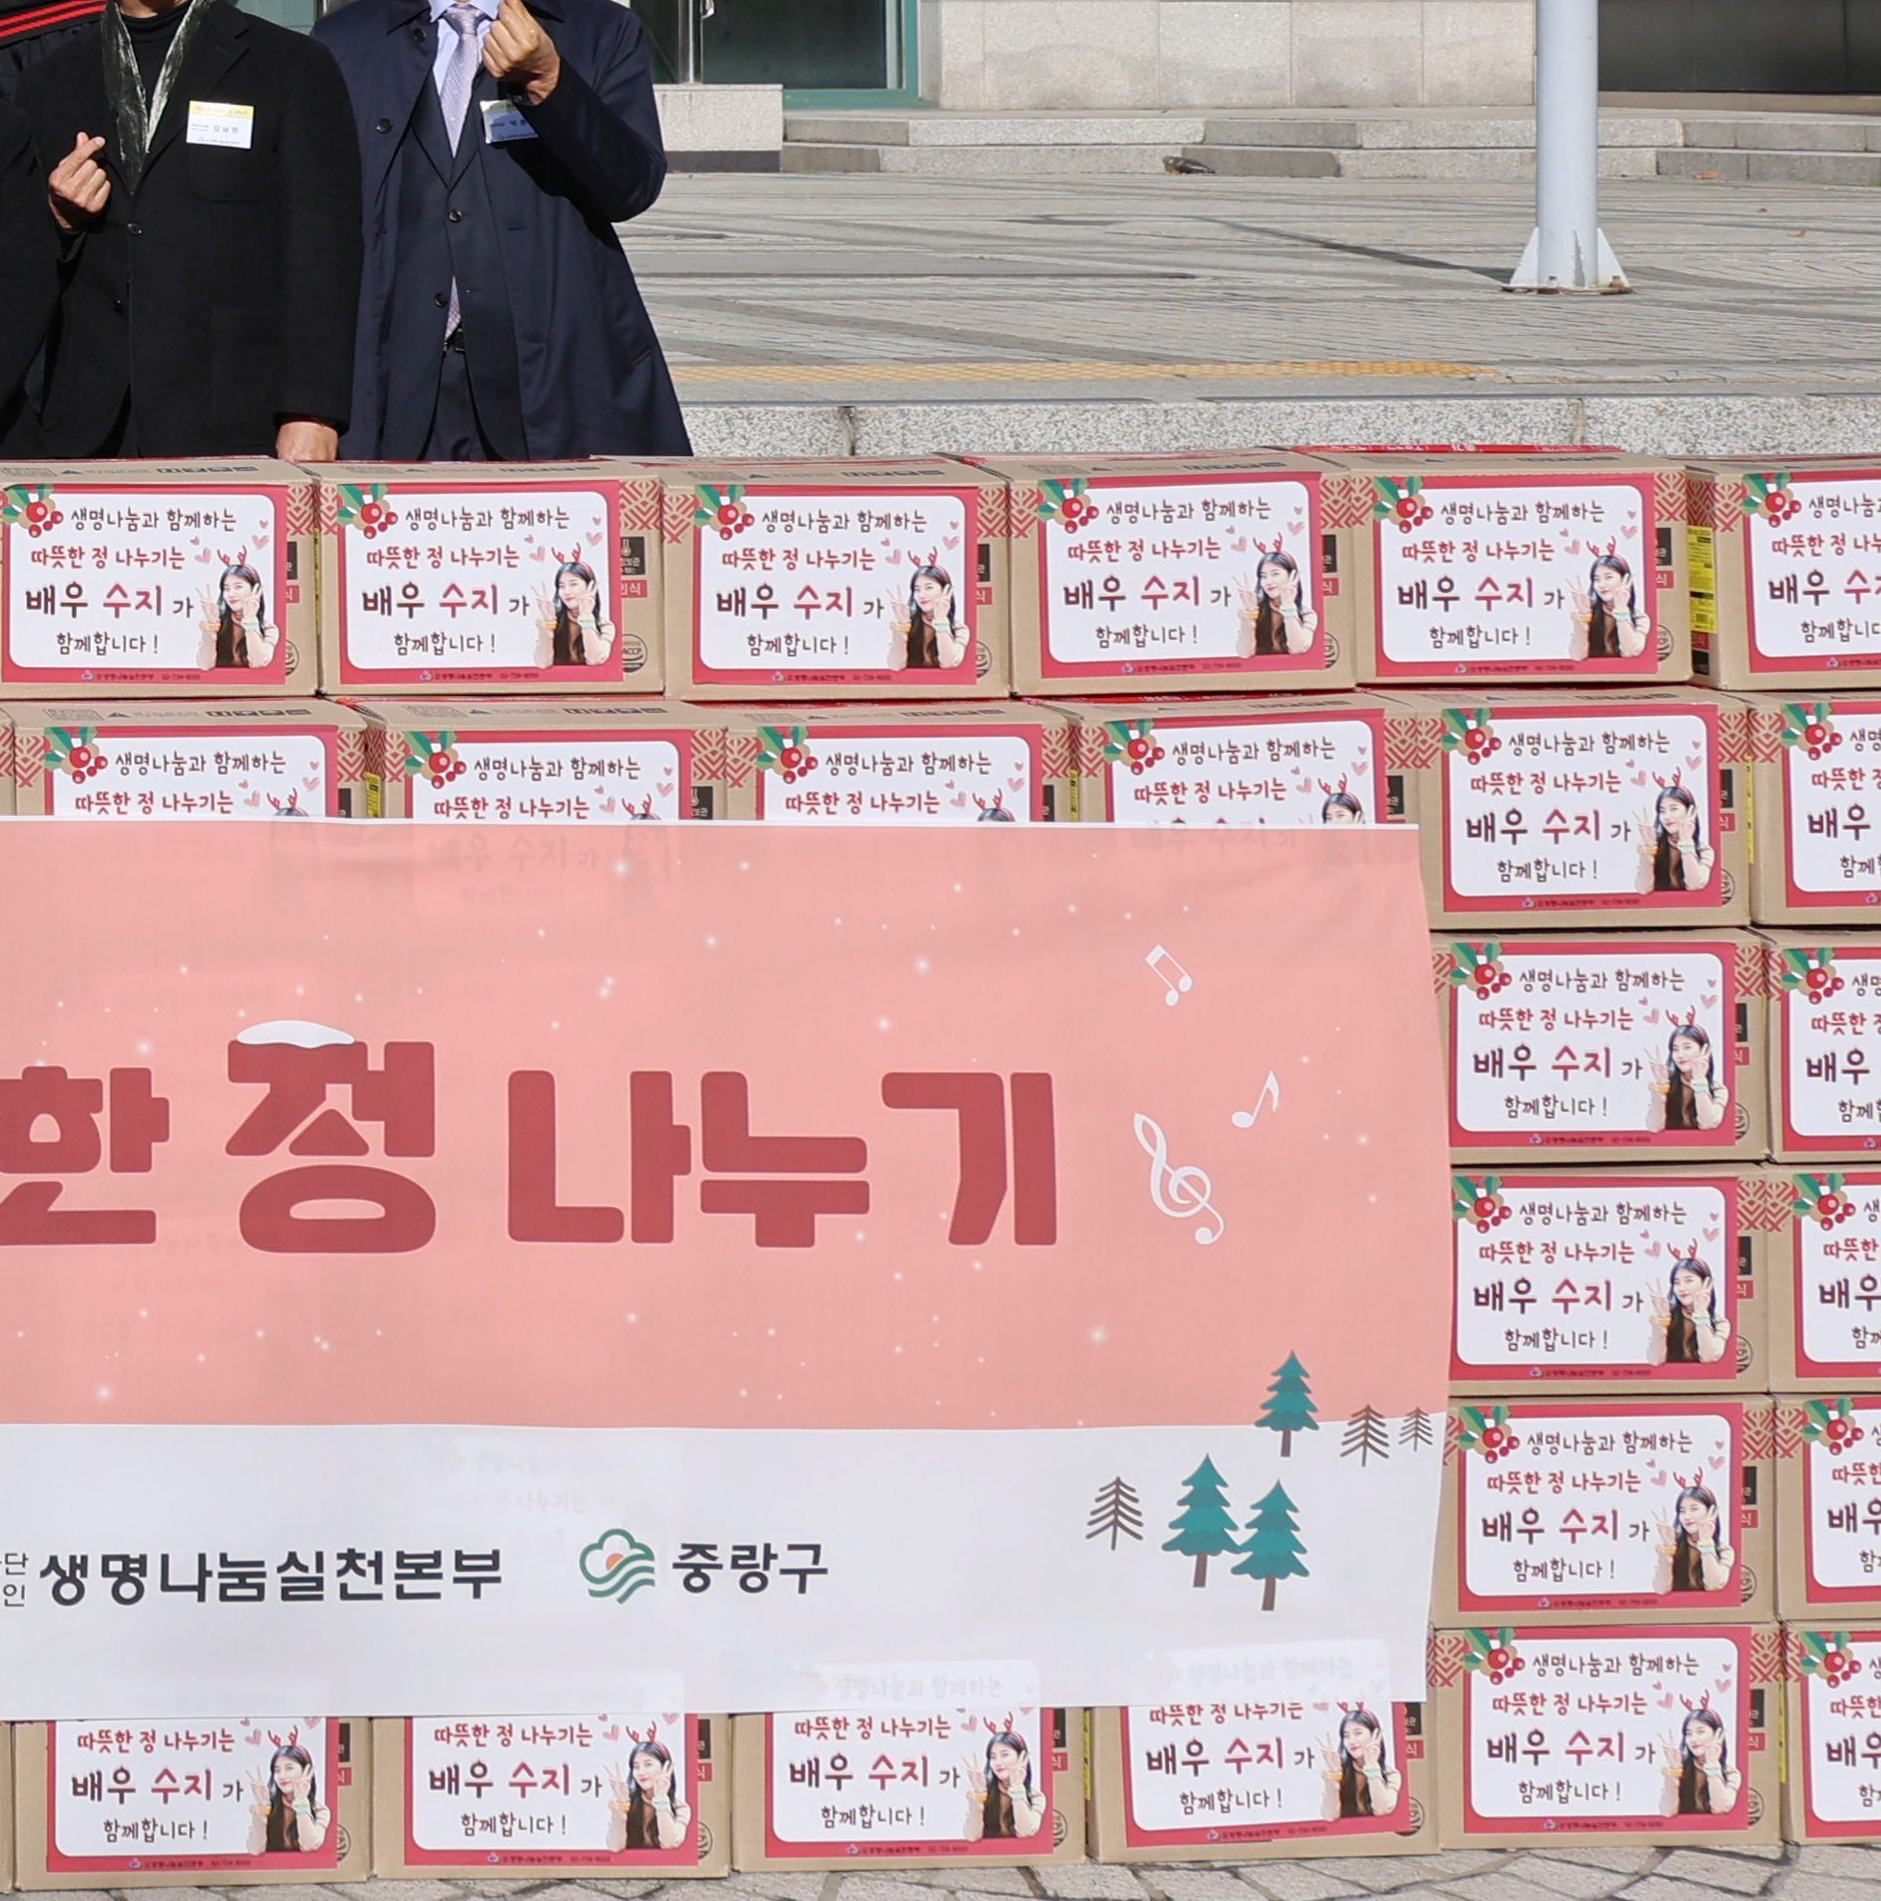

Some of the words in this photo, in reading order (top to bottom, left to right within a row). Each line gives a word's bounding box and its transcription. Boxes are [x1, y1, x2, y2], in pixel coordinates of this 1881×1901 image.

[762, 510, 850, 534] 생명나눔과
[857, 510, 927, 533] 함께하는
[722, 548, 776, 570] 따뜻한
[781, 547, 798, 572] 정
[807, 548, 875, 571] 나누기는
[716, 583, 779, 620] 배우
[794, 585, 852, 620] 수지
[116, 751, 206, 776] 생명나눔과
[214, 751, 286, 775] 함께하는
[75, 791, 131, 815] 따뜻한
[137, 790, 154, 816] 정
[163, 790, 233, 814] 나누기는
[223, 1039, 437, 1255] 정
[507, 1068, 1059, 1250] 나누기
[1520, 1201, 1608, 1226] 생명나눔과
[1616, 1202, 1686, 1225] 함께하는
[1479, 1241, 1534, 1264] 따뜻한
[1539, 1239, 1556, 1265] 정
[1565, 1241, 1634, 1264] 나누기는
[1473, 1277, 1537, 1314] 배우
[1552, 1279, 1611, 1314] 수지
[39, 1547, 502, 1607] 생명나눔실천본부
[672, 1542, 829, 1595] 중랑구
